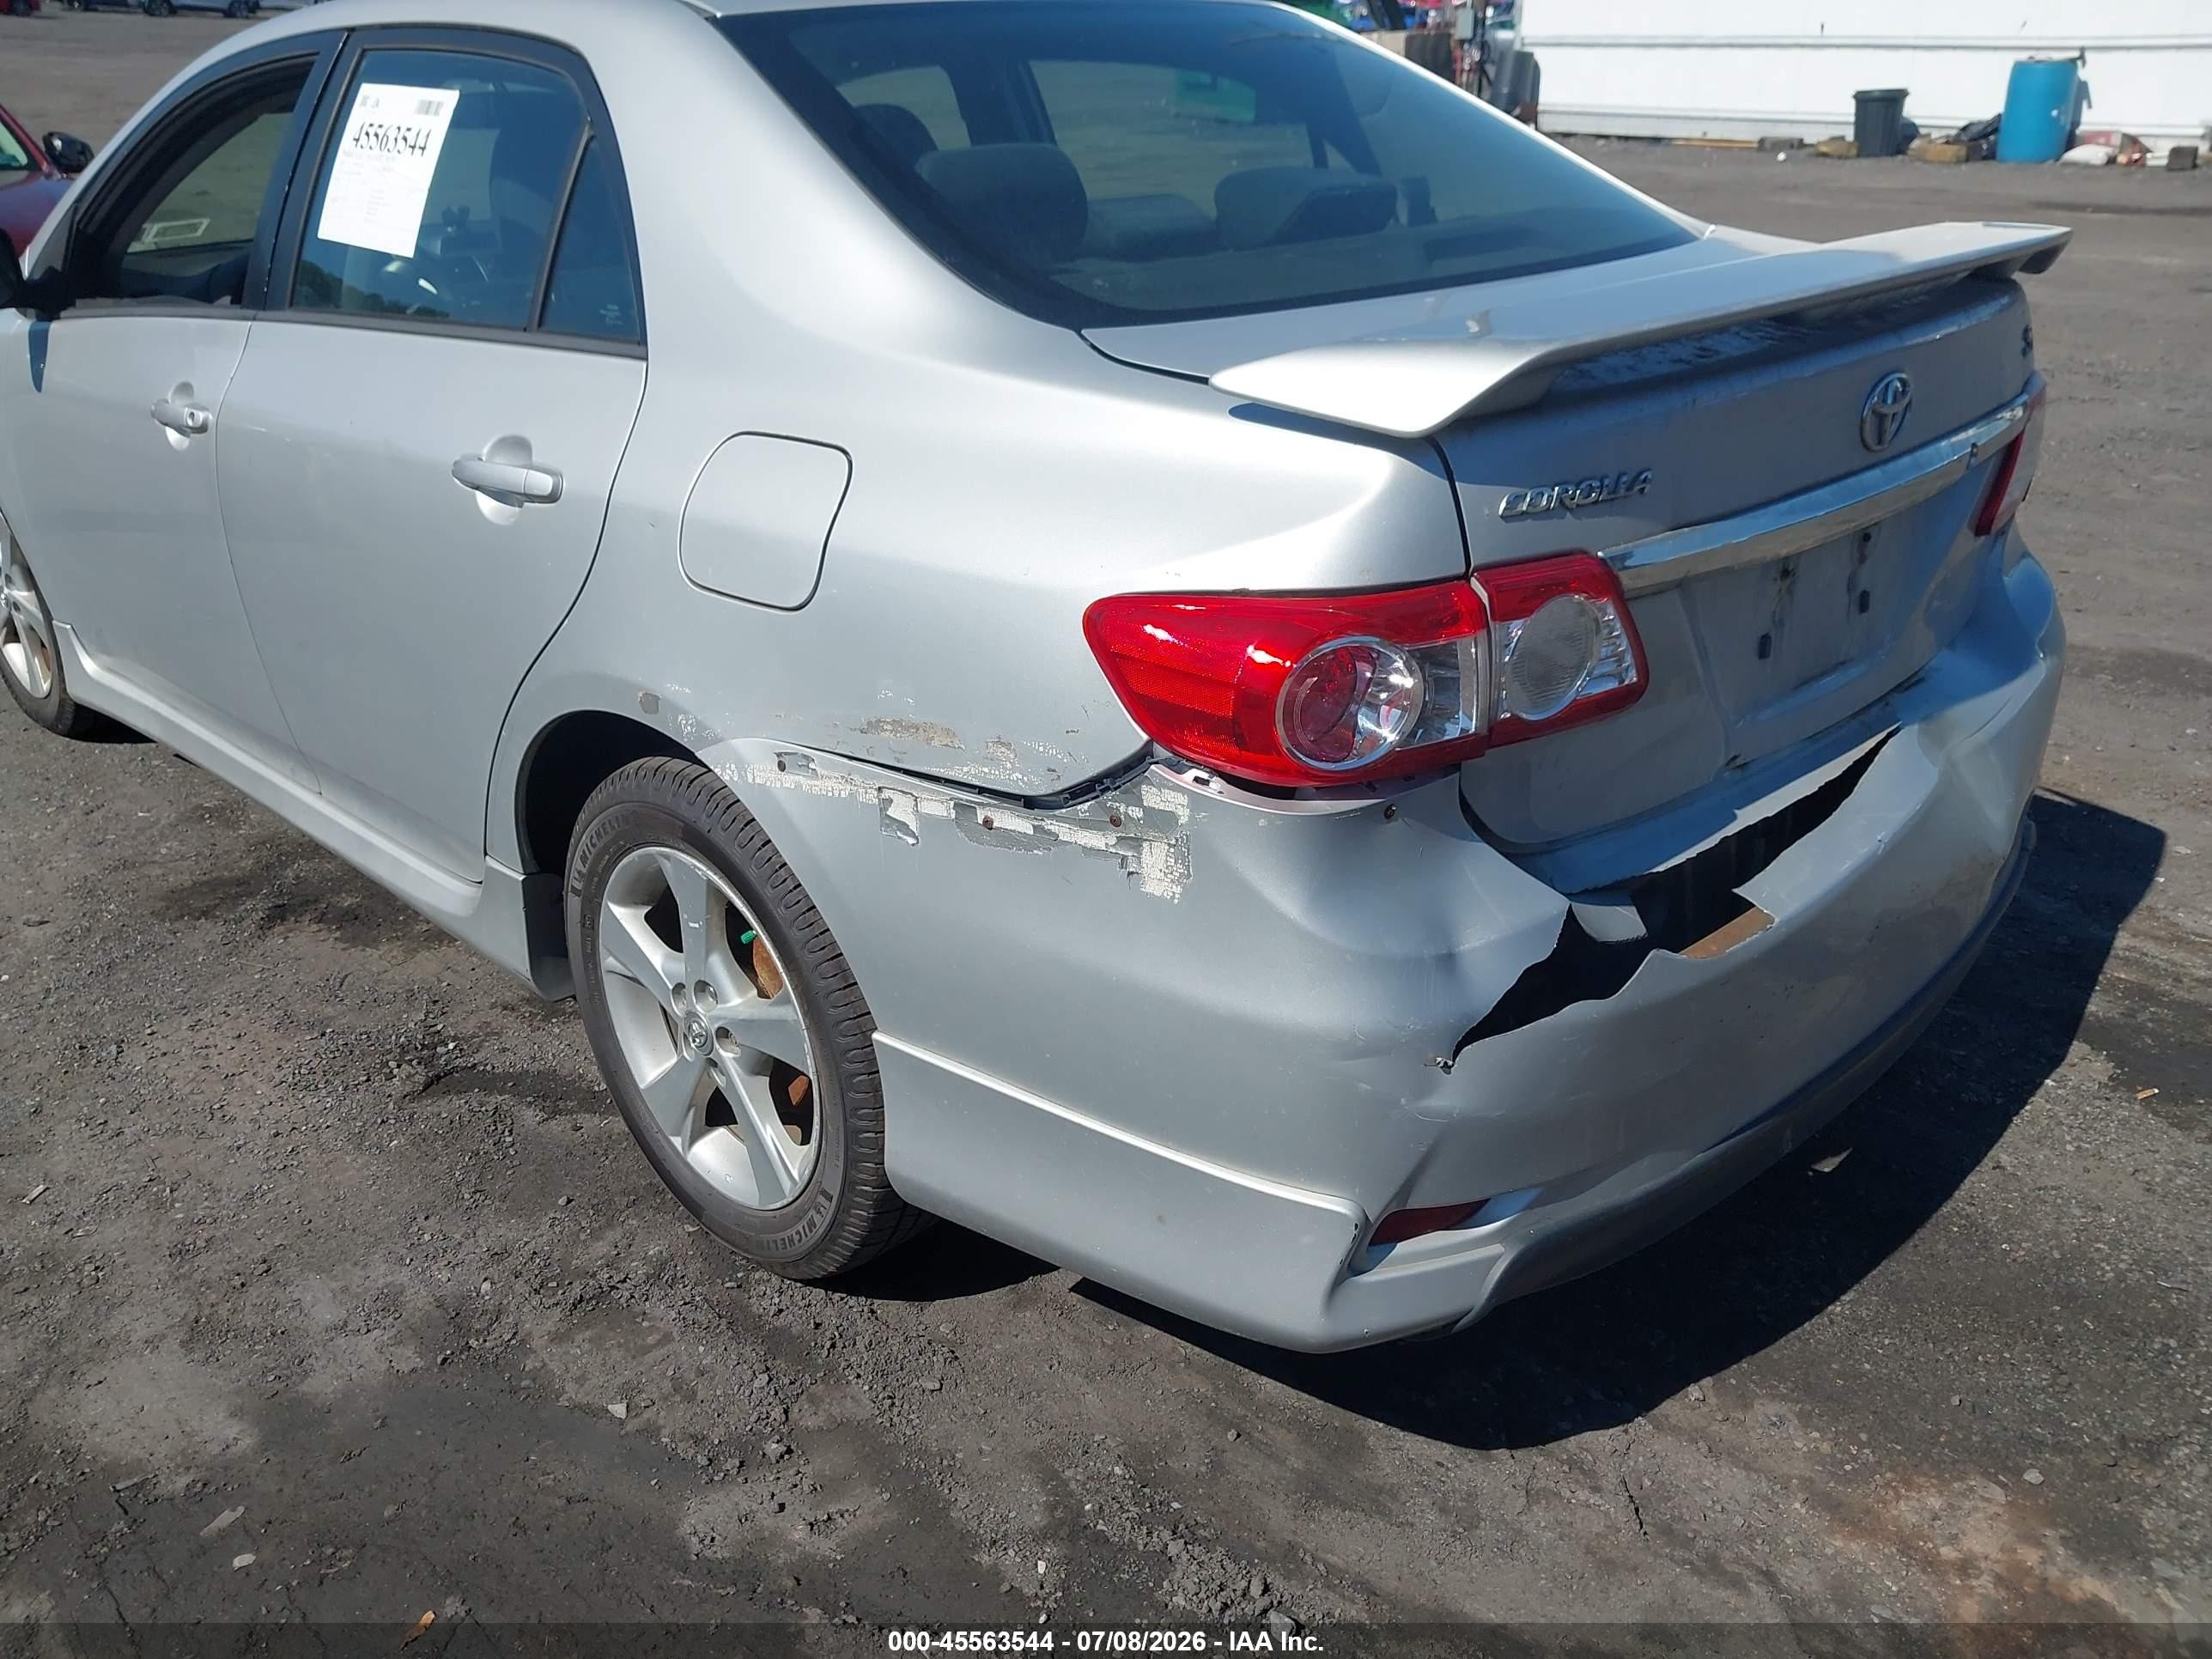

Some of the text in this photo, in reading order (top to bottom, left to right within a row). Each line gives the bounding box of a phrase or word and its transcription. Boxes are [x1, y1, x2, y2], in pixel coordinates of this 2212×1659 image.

[353, 122, 432, 156] 45563544
[1498, 467, 1653, 518] COROLLA
[579, 811, 634, 869] MICHELIN
[758, 1213, 817, 1251] MICHELIN
